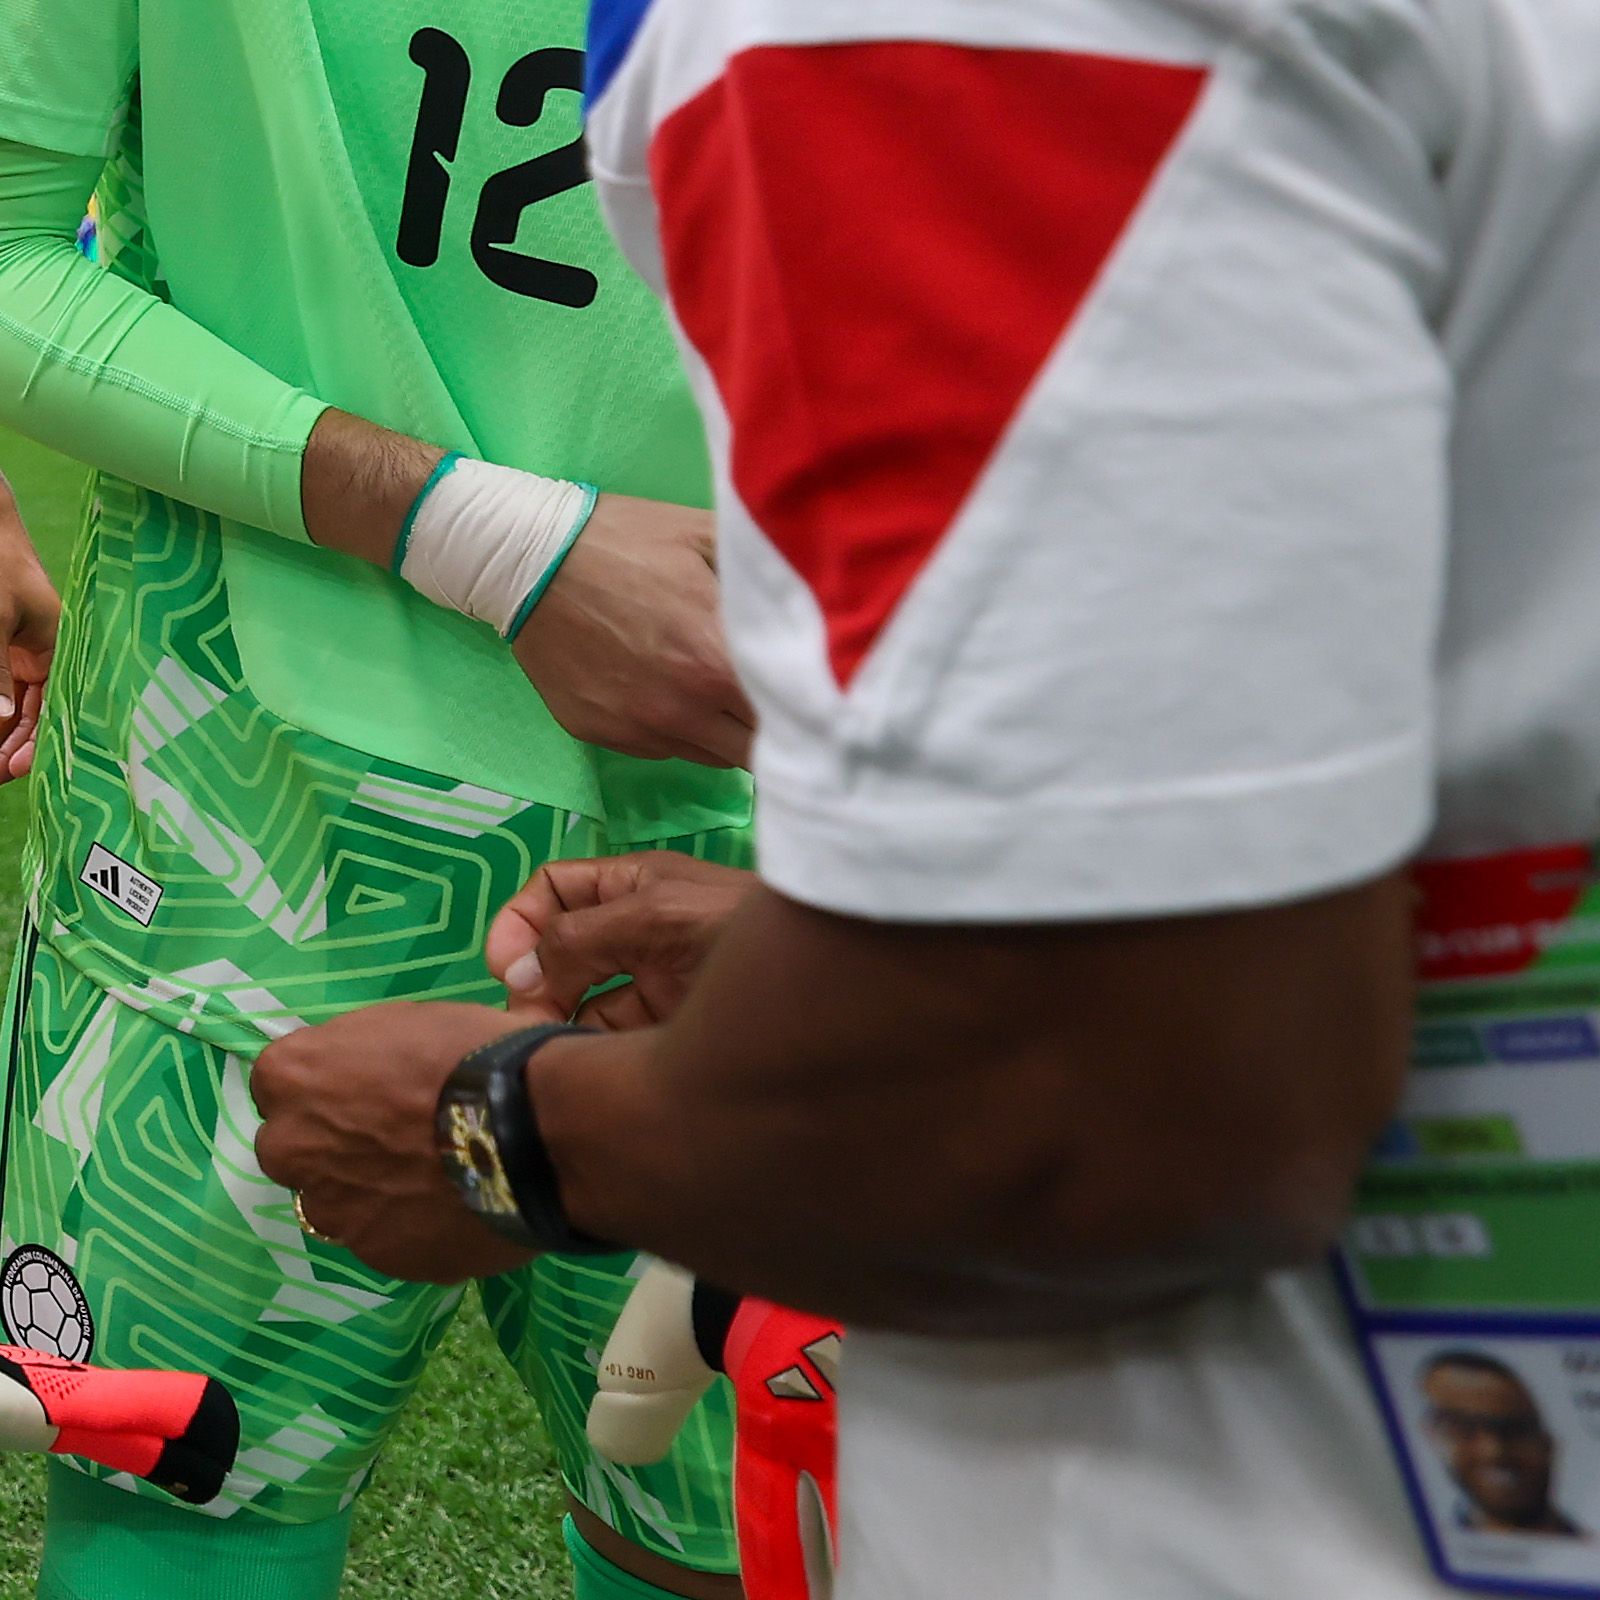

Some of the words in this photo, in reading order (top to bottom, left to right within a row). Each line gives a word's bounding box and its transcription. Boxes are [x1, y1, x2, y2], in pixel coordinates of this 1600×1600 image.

[396, 26, 598, 309] 12
[31, 1250, 74, 1287] COLOMBIANA
[71, 1286, 82, 1300] DE
